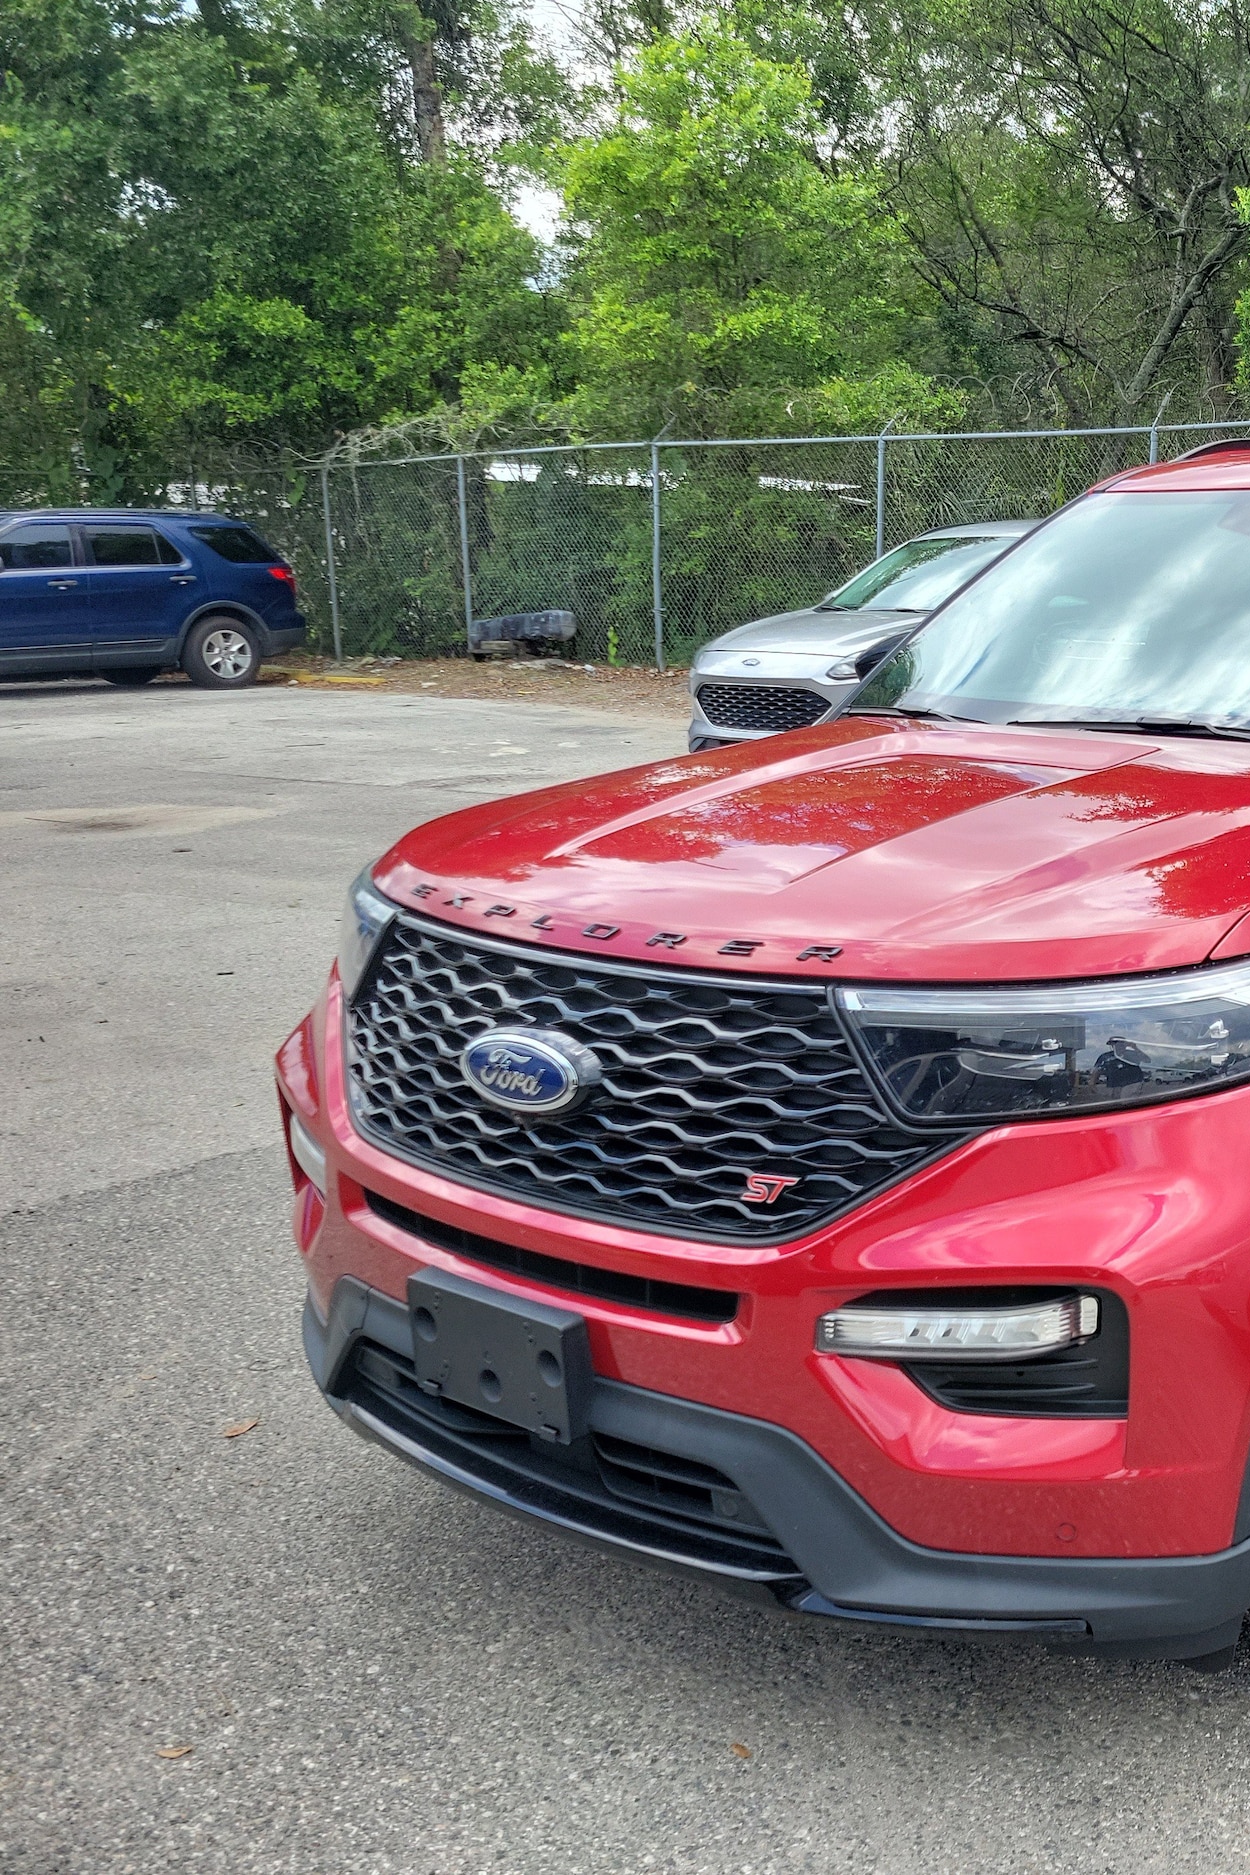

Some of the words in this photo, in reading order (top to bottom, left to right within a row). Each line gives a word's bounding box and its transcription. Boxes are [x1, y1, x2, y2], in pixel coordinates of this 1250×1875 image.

[410, 883, 845, 963] EXPLORER
[480, 1048, 546, 1097] Ford
[740, 1173, 802, 1204] ST
